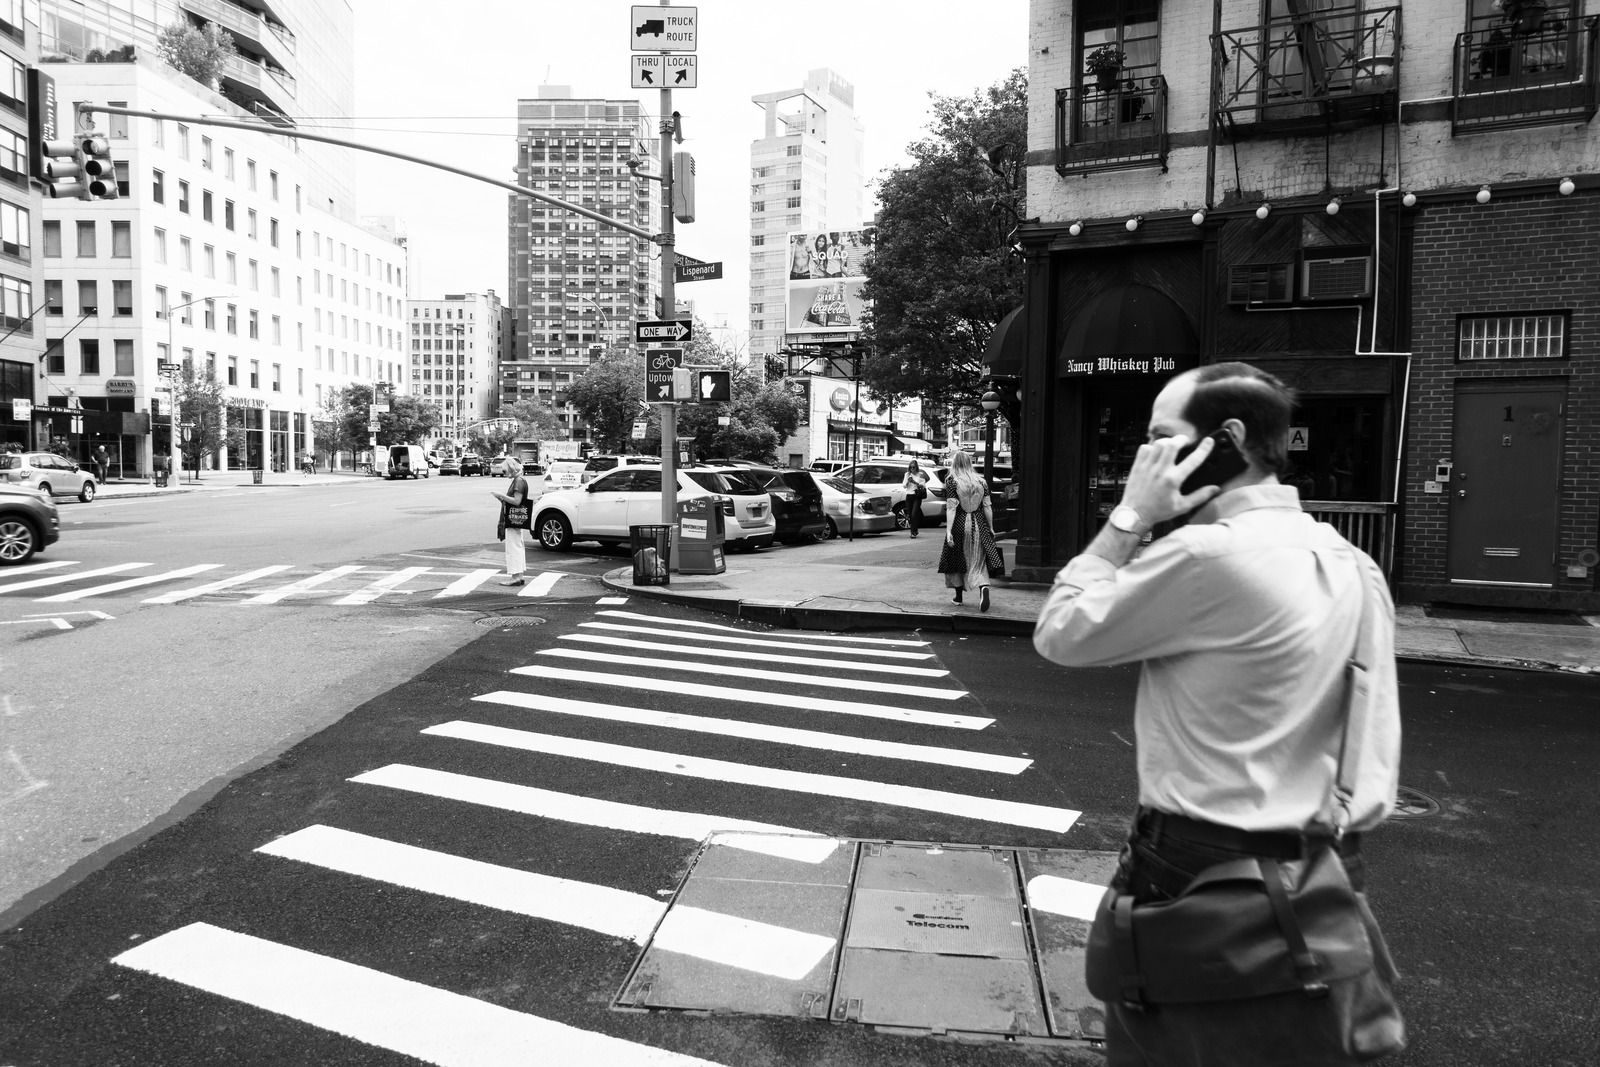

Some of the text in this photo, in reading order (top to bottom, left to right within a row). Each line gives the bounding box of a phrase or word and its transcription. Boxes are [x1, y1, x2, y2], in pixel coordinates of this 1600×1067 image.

[667, 17, 694, 26] TRUCK
[666, 32, 693, 41] ROUTE
[637, 57, 659, 67] THRU
[667, 57, 694, 67] LOCAL
[812, 250, 848, 260] SQUAD
[682, 263, 715, 277] Lispenard
[643, 326, 684, 336] ONE WAY
[1067, 357, 1175, 374] Nancy Whiskey Pub
[648, 373, 673, 384] Uptow
[1503, 405, 1514, 422] 1
[1291, 430, 1305, 444] A
[906, 920, 970, 930] Telecom
